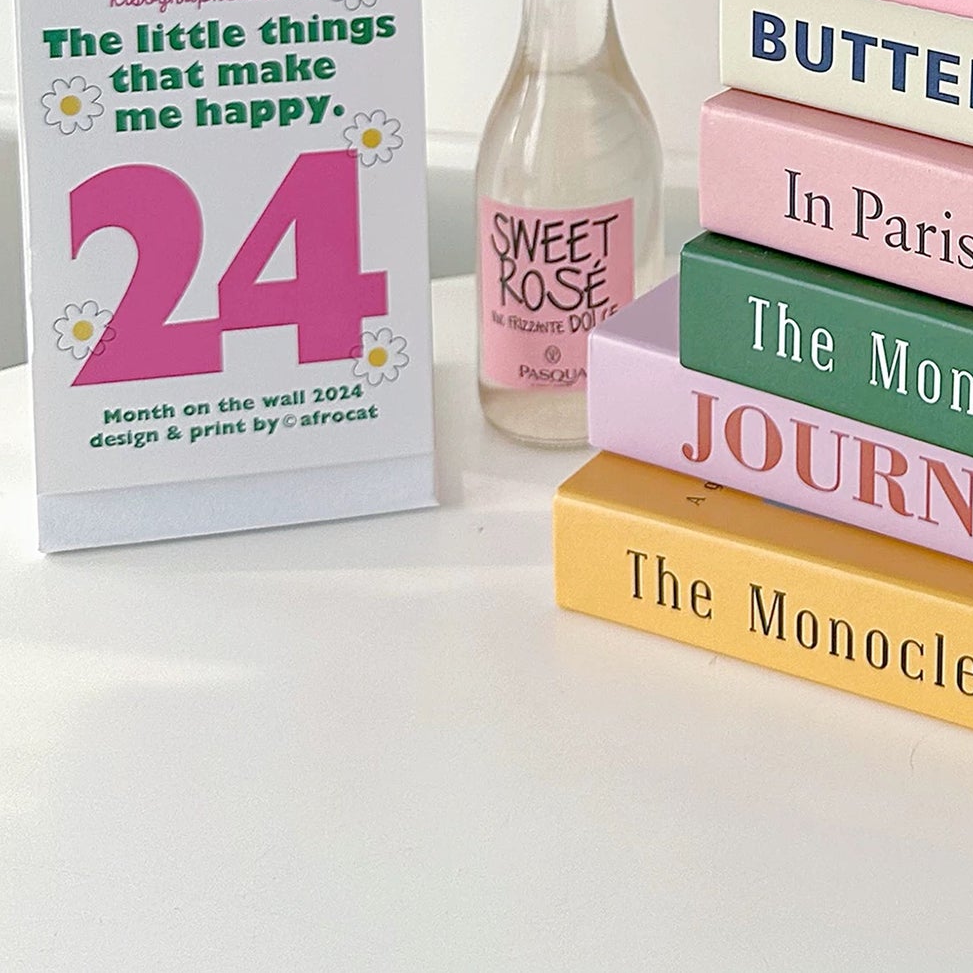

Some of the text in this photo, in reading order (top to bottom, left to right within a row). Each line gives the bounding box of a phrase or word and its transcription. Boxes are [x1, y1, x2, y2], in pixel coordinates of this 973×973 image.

[43, 14, 397, 58] The little things
[110, 53, 337, 93] that make
[115, 94, 345, 132] me happy.
[784, 168, 833, 233] In
[491, 212, 619, 264] SWEET
[70, 148, 389, 388] 24
[500, 257, 610, 312] ROSÉ
[746, 295, 835, 373] The
[104, 383, 364, 425] Month on the wall 2024
[90, 428, 159, 450] design
[167, 425, 183, 441] &
[190, 418, 247, 443] print
[626, 549, 713, 621] The
